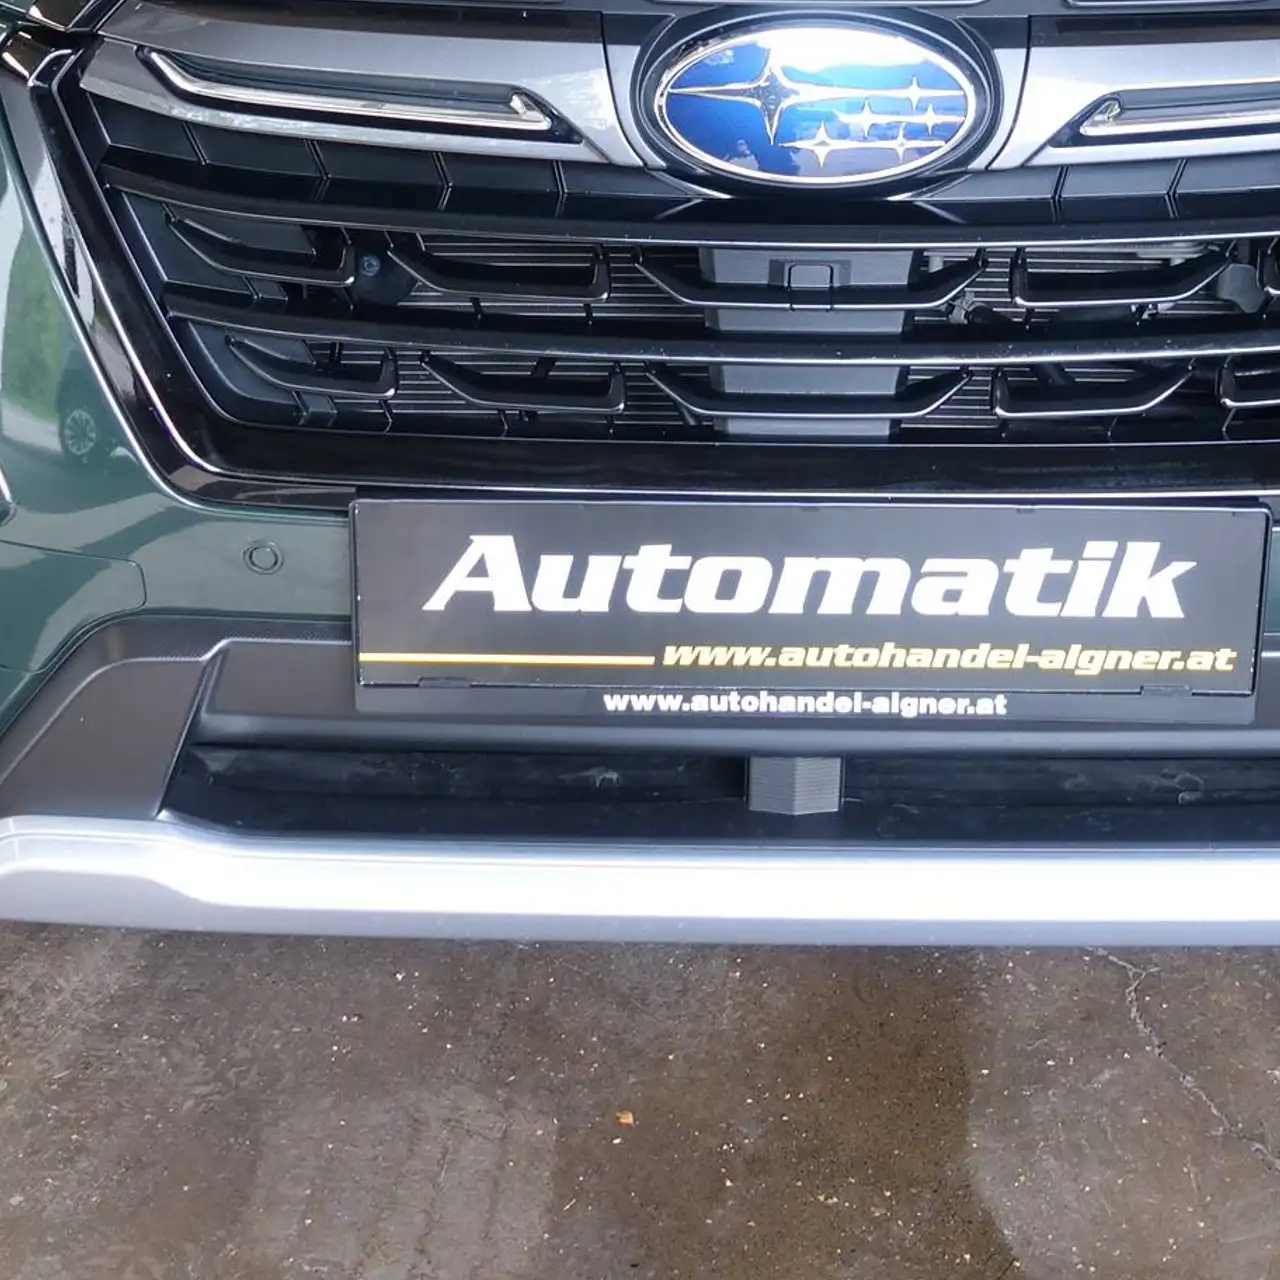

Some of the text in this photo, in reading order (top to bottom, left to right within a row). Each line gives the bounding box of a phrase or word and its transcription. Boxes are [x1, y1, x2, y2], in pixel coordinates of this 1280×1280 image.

[422, 535, 1196, 619] Automatik
[662, 641, 1237, 676] www.autohandel-aigner.at
[603, 690, 1008, 718] www.autohandel-aigner.at
